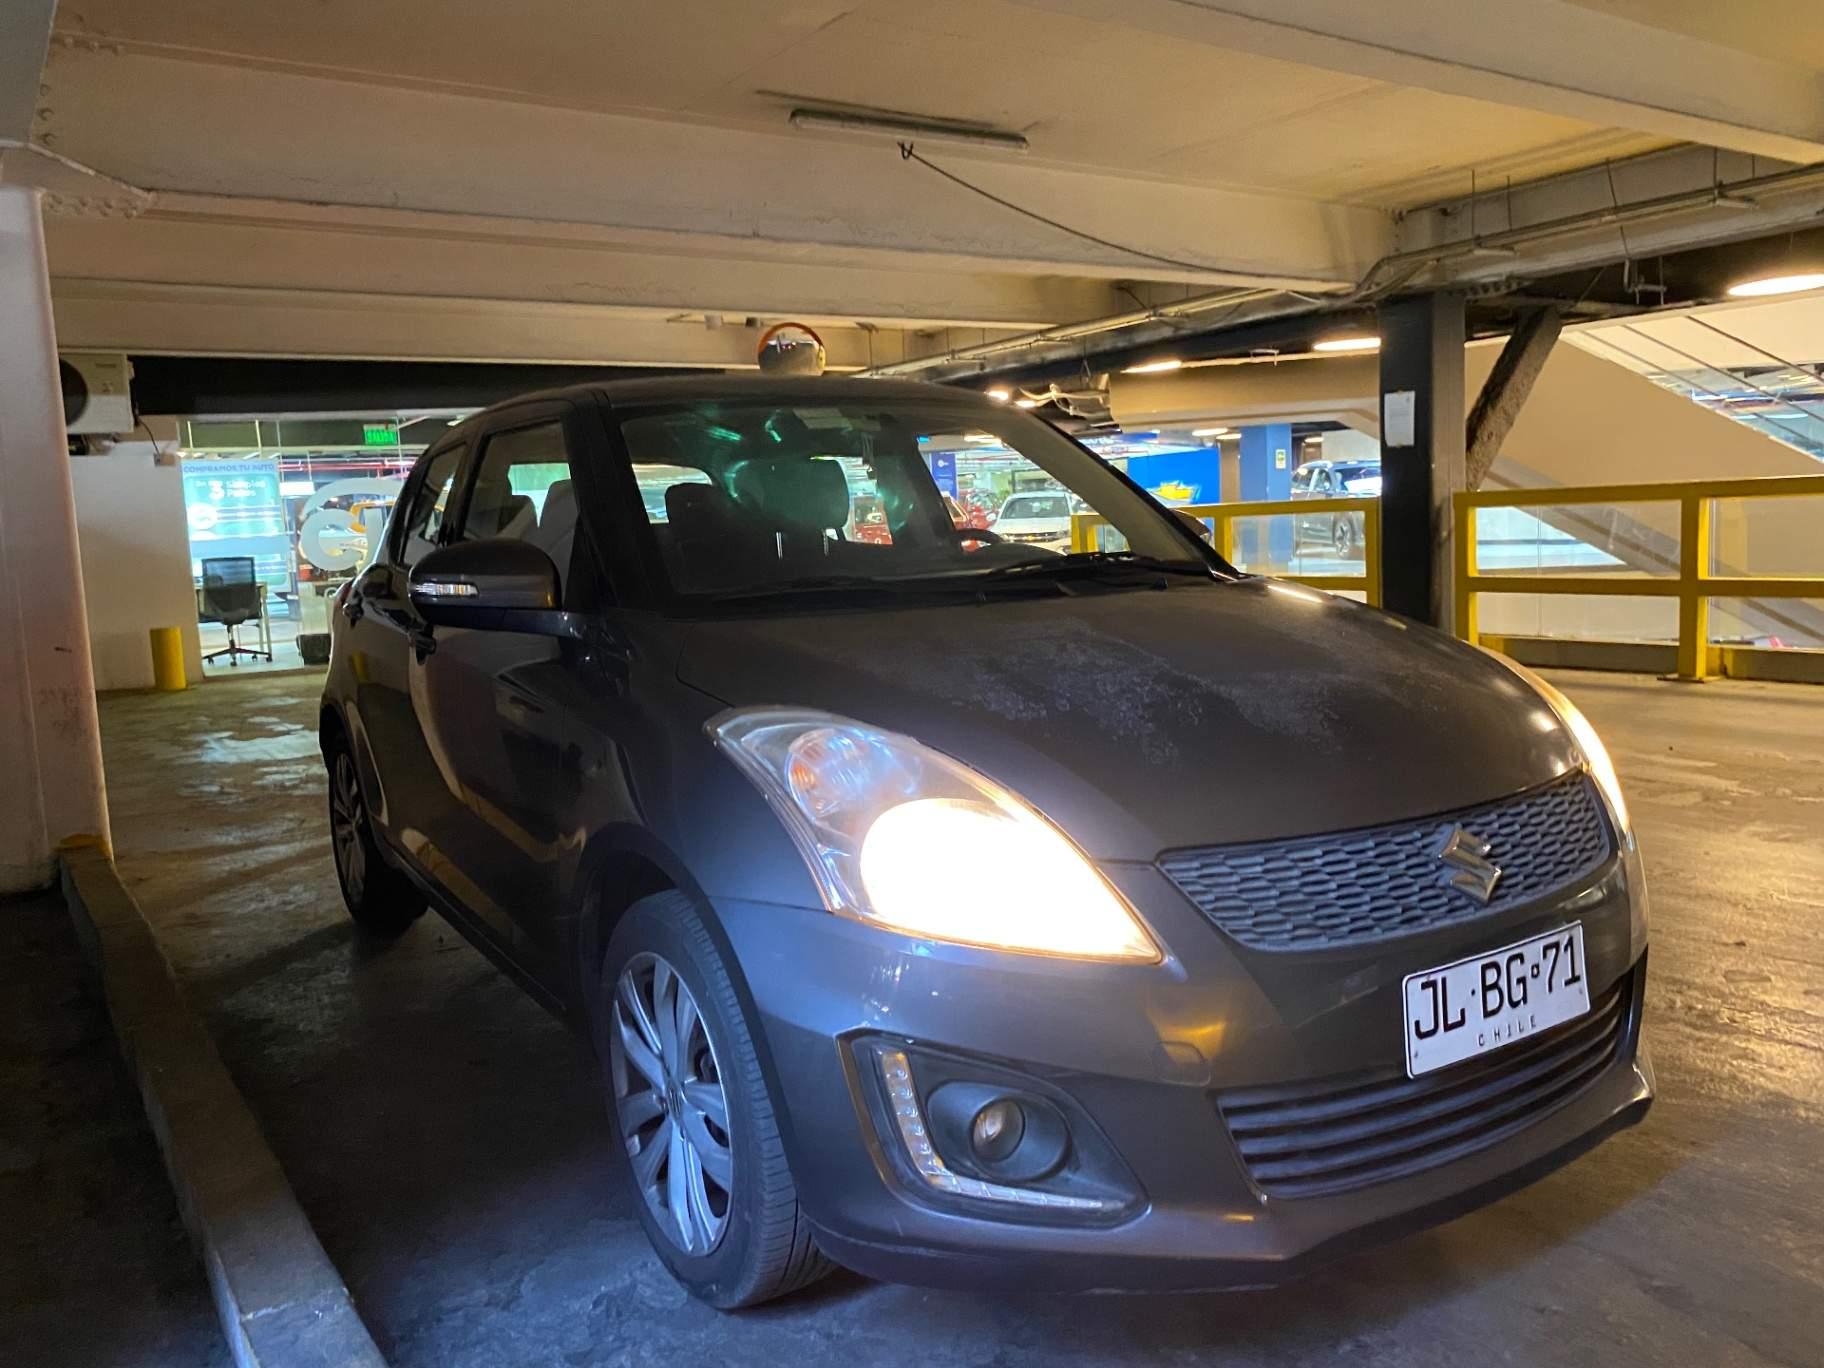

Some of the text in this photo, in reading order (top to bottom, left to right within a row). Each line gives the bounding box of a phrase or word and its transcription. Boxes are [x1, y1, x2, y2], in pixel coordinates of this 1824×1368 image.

[183, 463, 238, 473] COMPRAMOS
[239, 463, 250, 472] TU
[1478, 1015, 1537, 1047] CHILE
